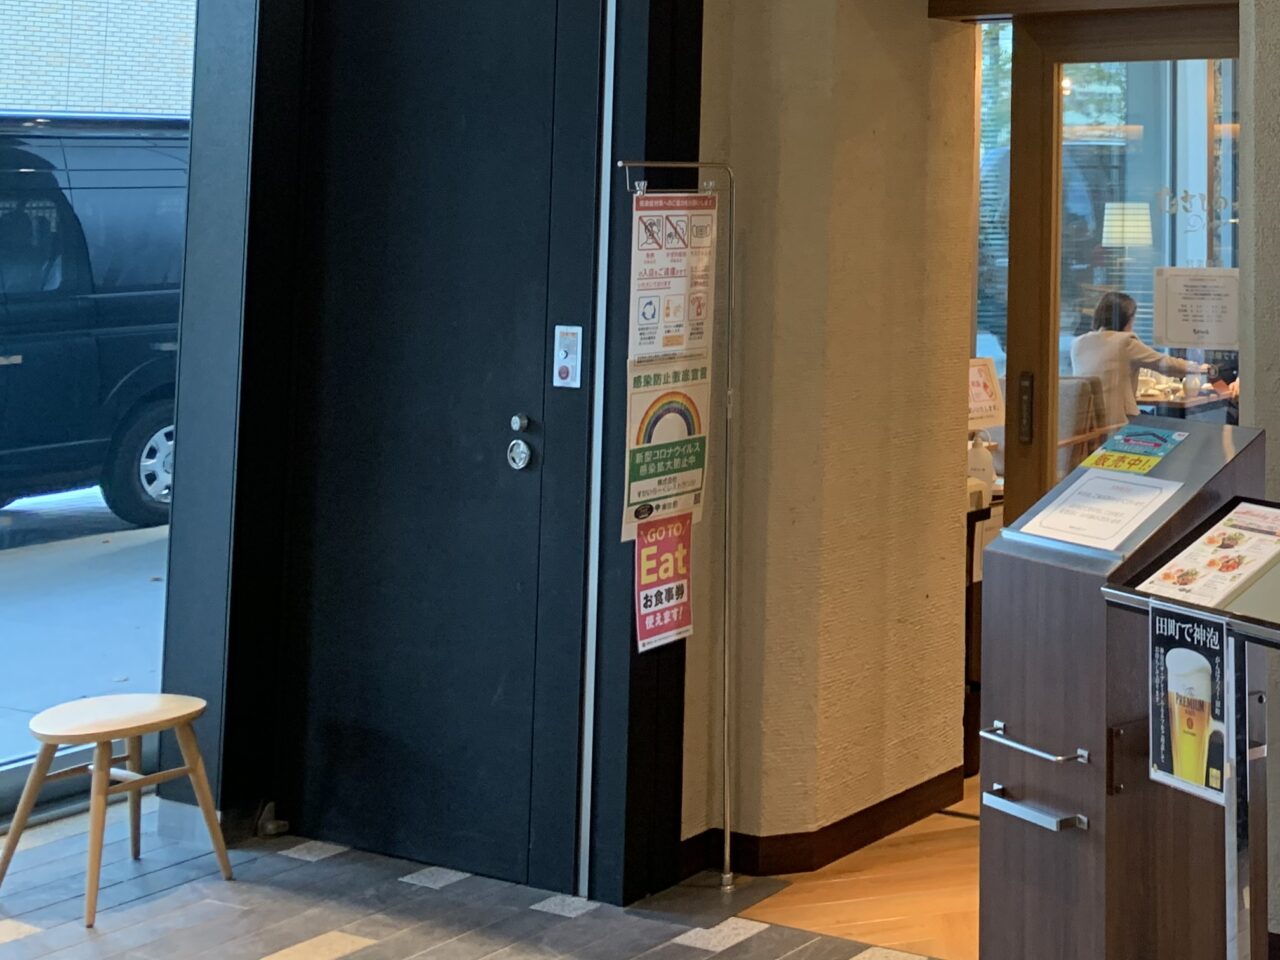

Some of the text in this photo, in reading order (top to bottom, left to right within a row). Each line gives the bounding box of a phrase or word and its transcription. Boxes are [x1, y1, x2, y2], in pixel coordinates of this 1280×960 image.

[635, 442, 701, 464] 新型コロナウイルス
[647, 522, 683, 543] GO TO
[641, 543, 688, 585] Eat
[643, 583, 685, 609] お食事券
[1155, 616, 1220, 650] 田町で神泡
